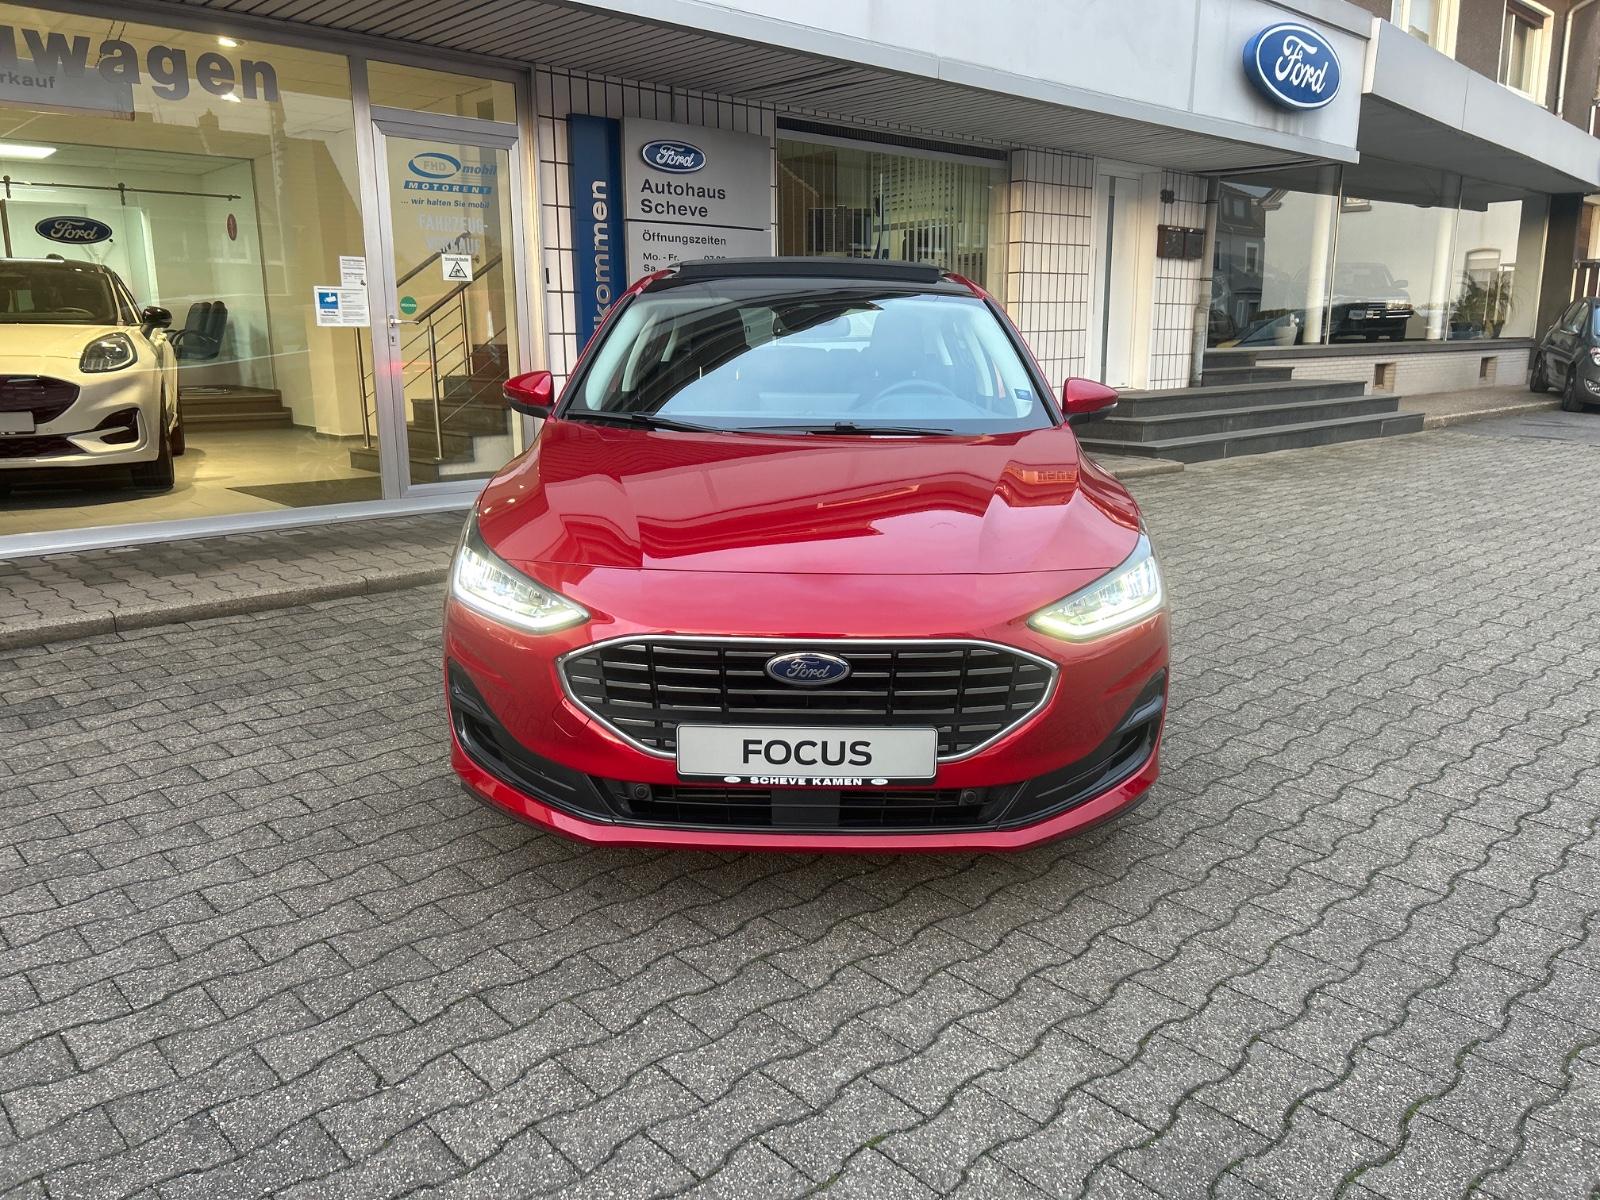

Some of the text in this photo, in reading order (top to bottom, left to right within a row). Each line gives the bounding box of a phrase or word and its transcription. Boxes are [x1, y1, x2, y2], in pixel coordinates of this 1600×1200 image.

[0, 25, 279, 102] wagen
[1275, 35, 1329, 94] Ford
[656, 145, 695, 168] Ford
[423, 160, 497, 176] FHD mobil
[408, 181, 489, 194] MOTORENT
[640, 178, 726, 200] Autohaus
[426, 198, 451, 206] halten
[453, 199, 466, 207] Sie
[468, 200, 489, 209] mobil
[640, 198, 708, 218] Scheve
[50, 220, 98, 240] Ford
[642, 229, 727, 246] Öffnungszeiten
[642, 252, 661, 261] Mo.
[668, 253, 680, 262] Fr.
[786, 659, 831, 678] Ford
[743, 739, 872, 766] FOCUS
[750, 776, 806, 785] SCHEVE
[812, 777, 862, 786] KAMEN
